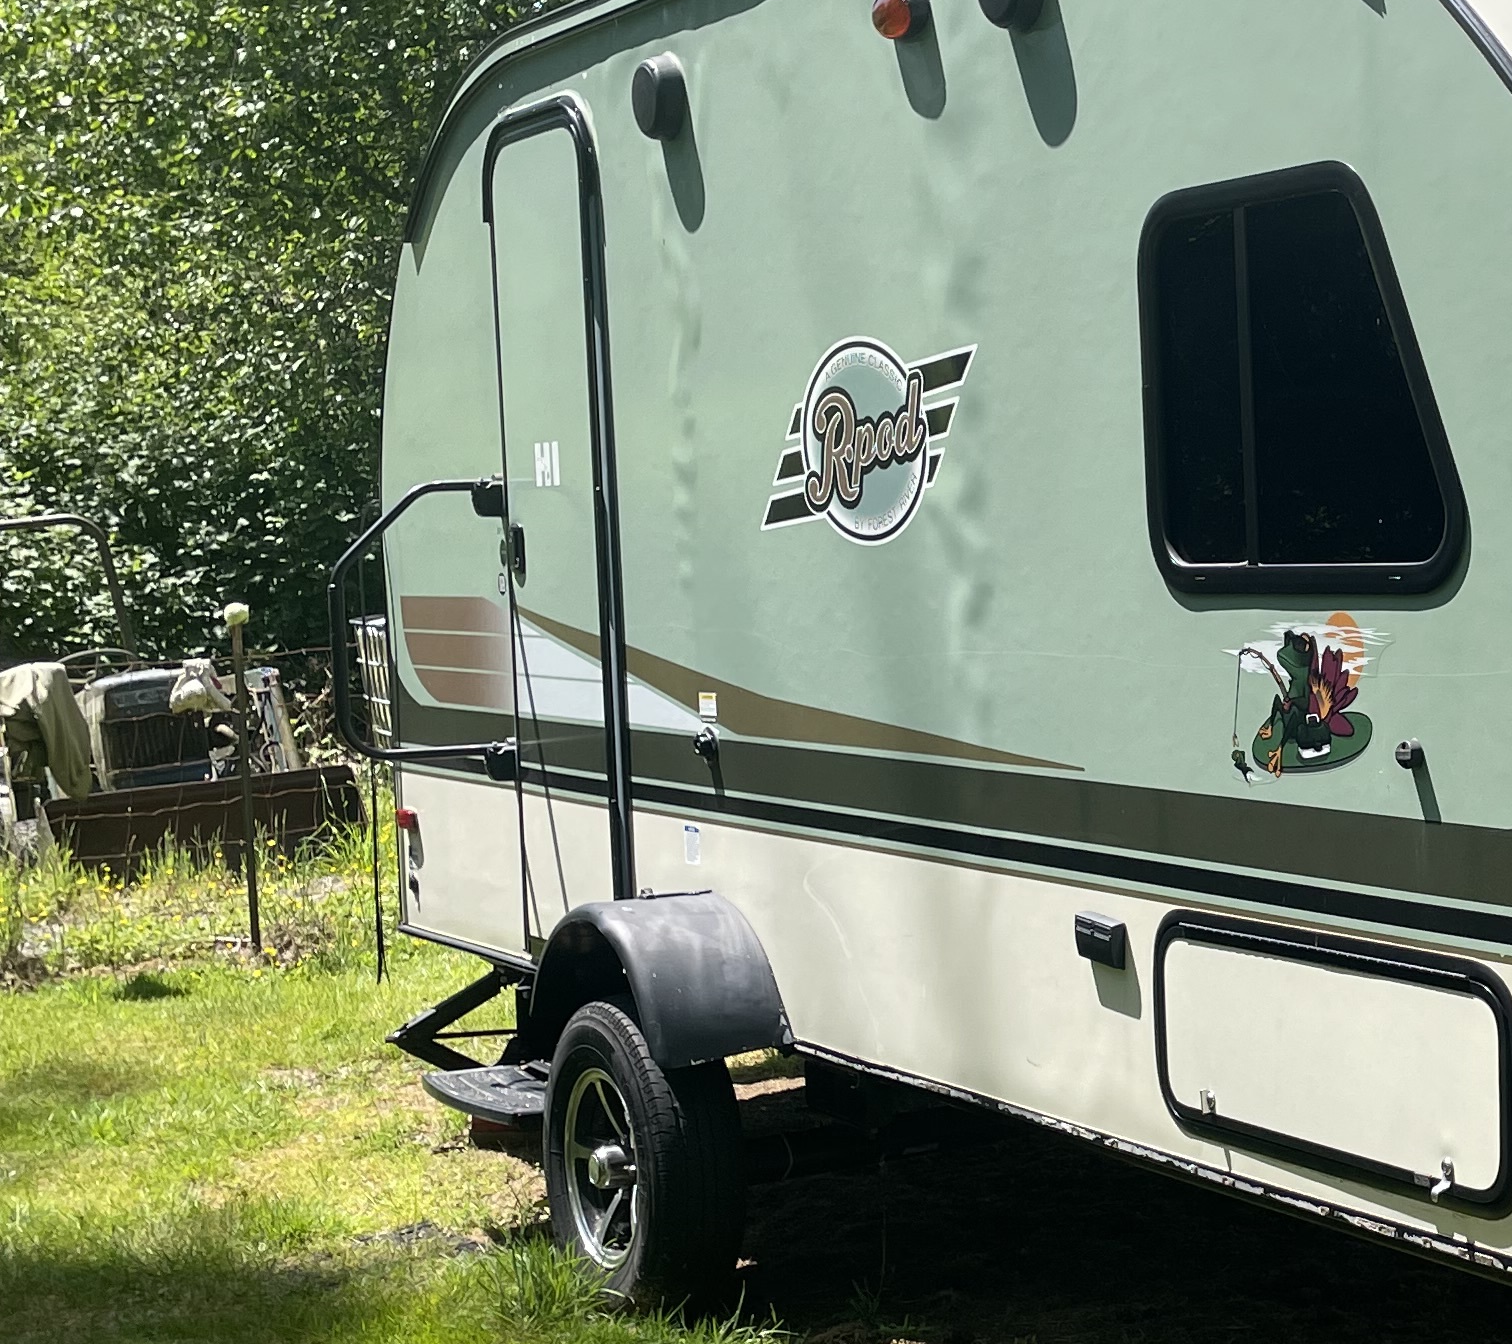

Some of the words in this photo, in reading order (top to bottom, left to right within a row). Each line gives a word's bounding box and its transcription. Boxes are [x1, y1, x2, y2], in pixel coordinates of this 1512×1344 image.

[868, 354, 903, 392] CLASSIC
[854, 516, 865, 531] BY
[867, 506, 898, 531] FOREST
[899, 472, 918, 511] RIVER
